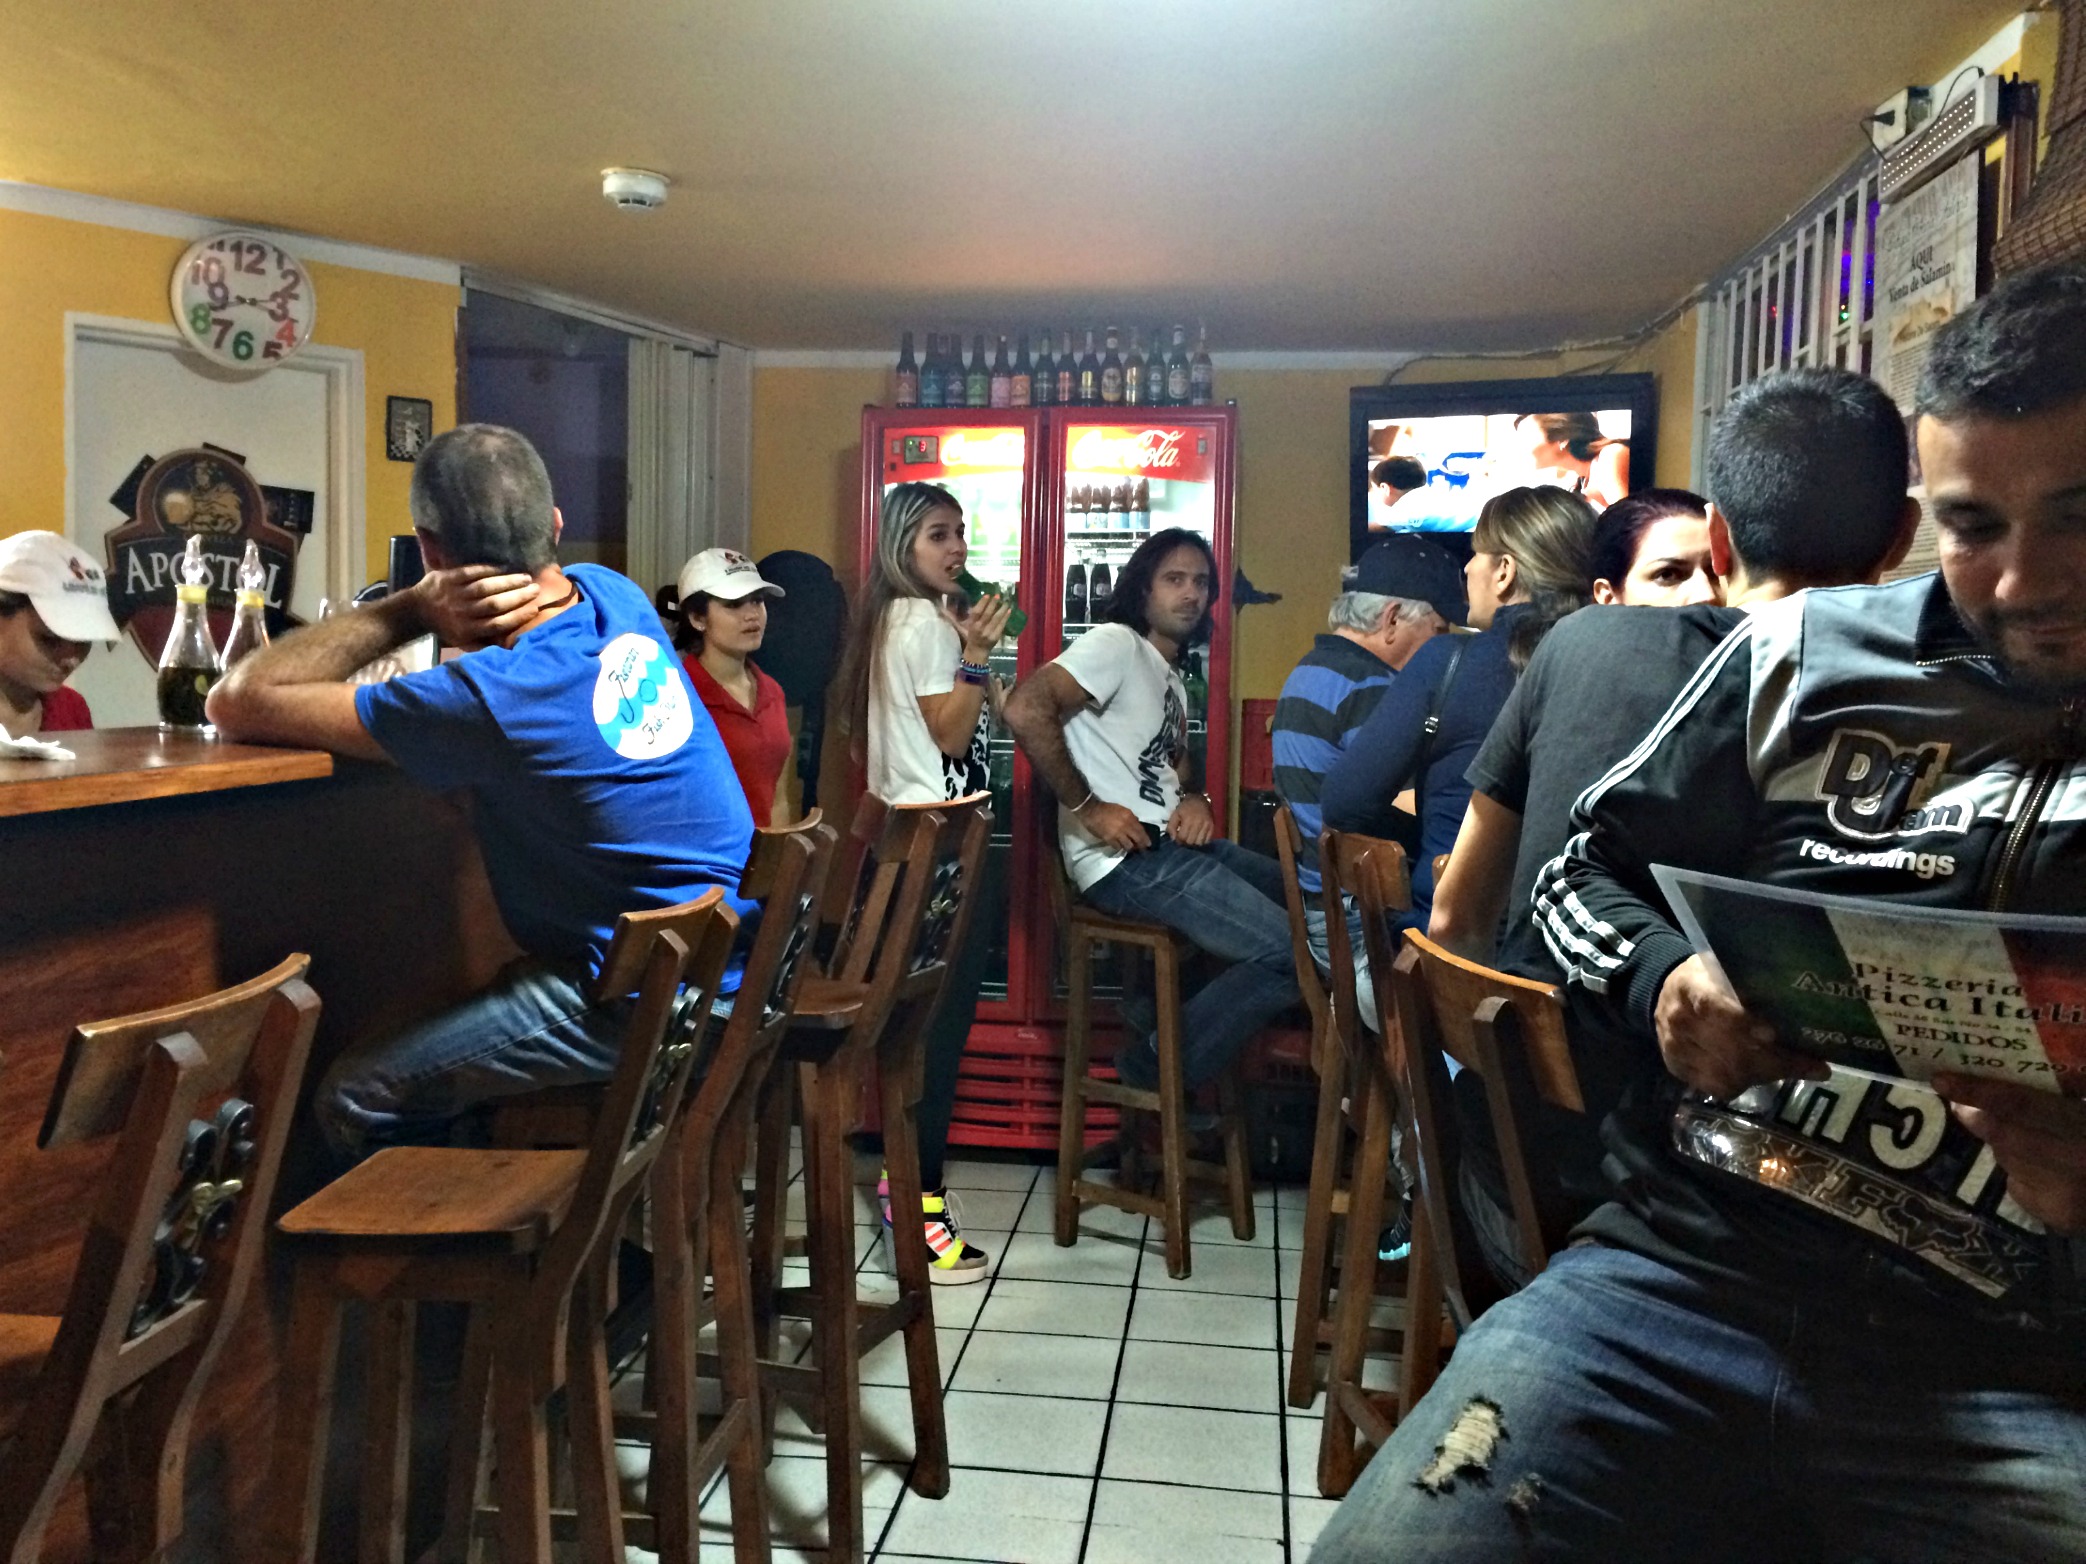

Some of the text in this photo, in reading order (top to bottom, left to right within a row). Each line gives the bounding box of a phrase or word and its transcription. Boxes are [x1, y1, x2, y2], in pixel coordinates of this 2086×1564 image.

[191, 257, 225, 287] 10
[230, 240, 267, 276] 12
[208, 282, 229, 312] 9
[280, 268, 301, 301] 2
[191, 303, 212, 335] 8
[268, 291, 291, 323] 3
[211, 317, 234, 349] 7
[232, 330, 255, 361] 6
[275, 318, 297, 348] 4
[1821, 732, 1940, 798] Def
[1834, 766, 1963, 833] Jam
[1800, 838, 1956, 880] recordings
[1790, 970, 1951, 1012] Antica
[1855, 963, 2025, 997] Pizzeria
[1894, 1024, 2029, 1051] PEDIDOS
